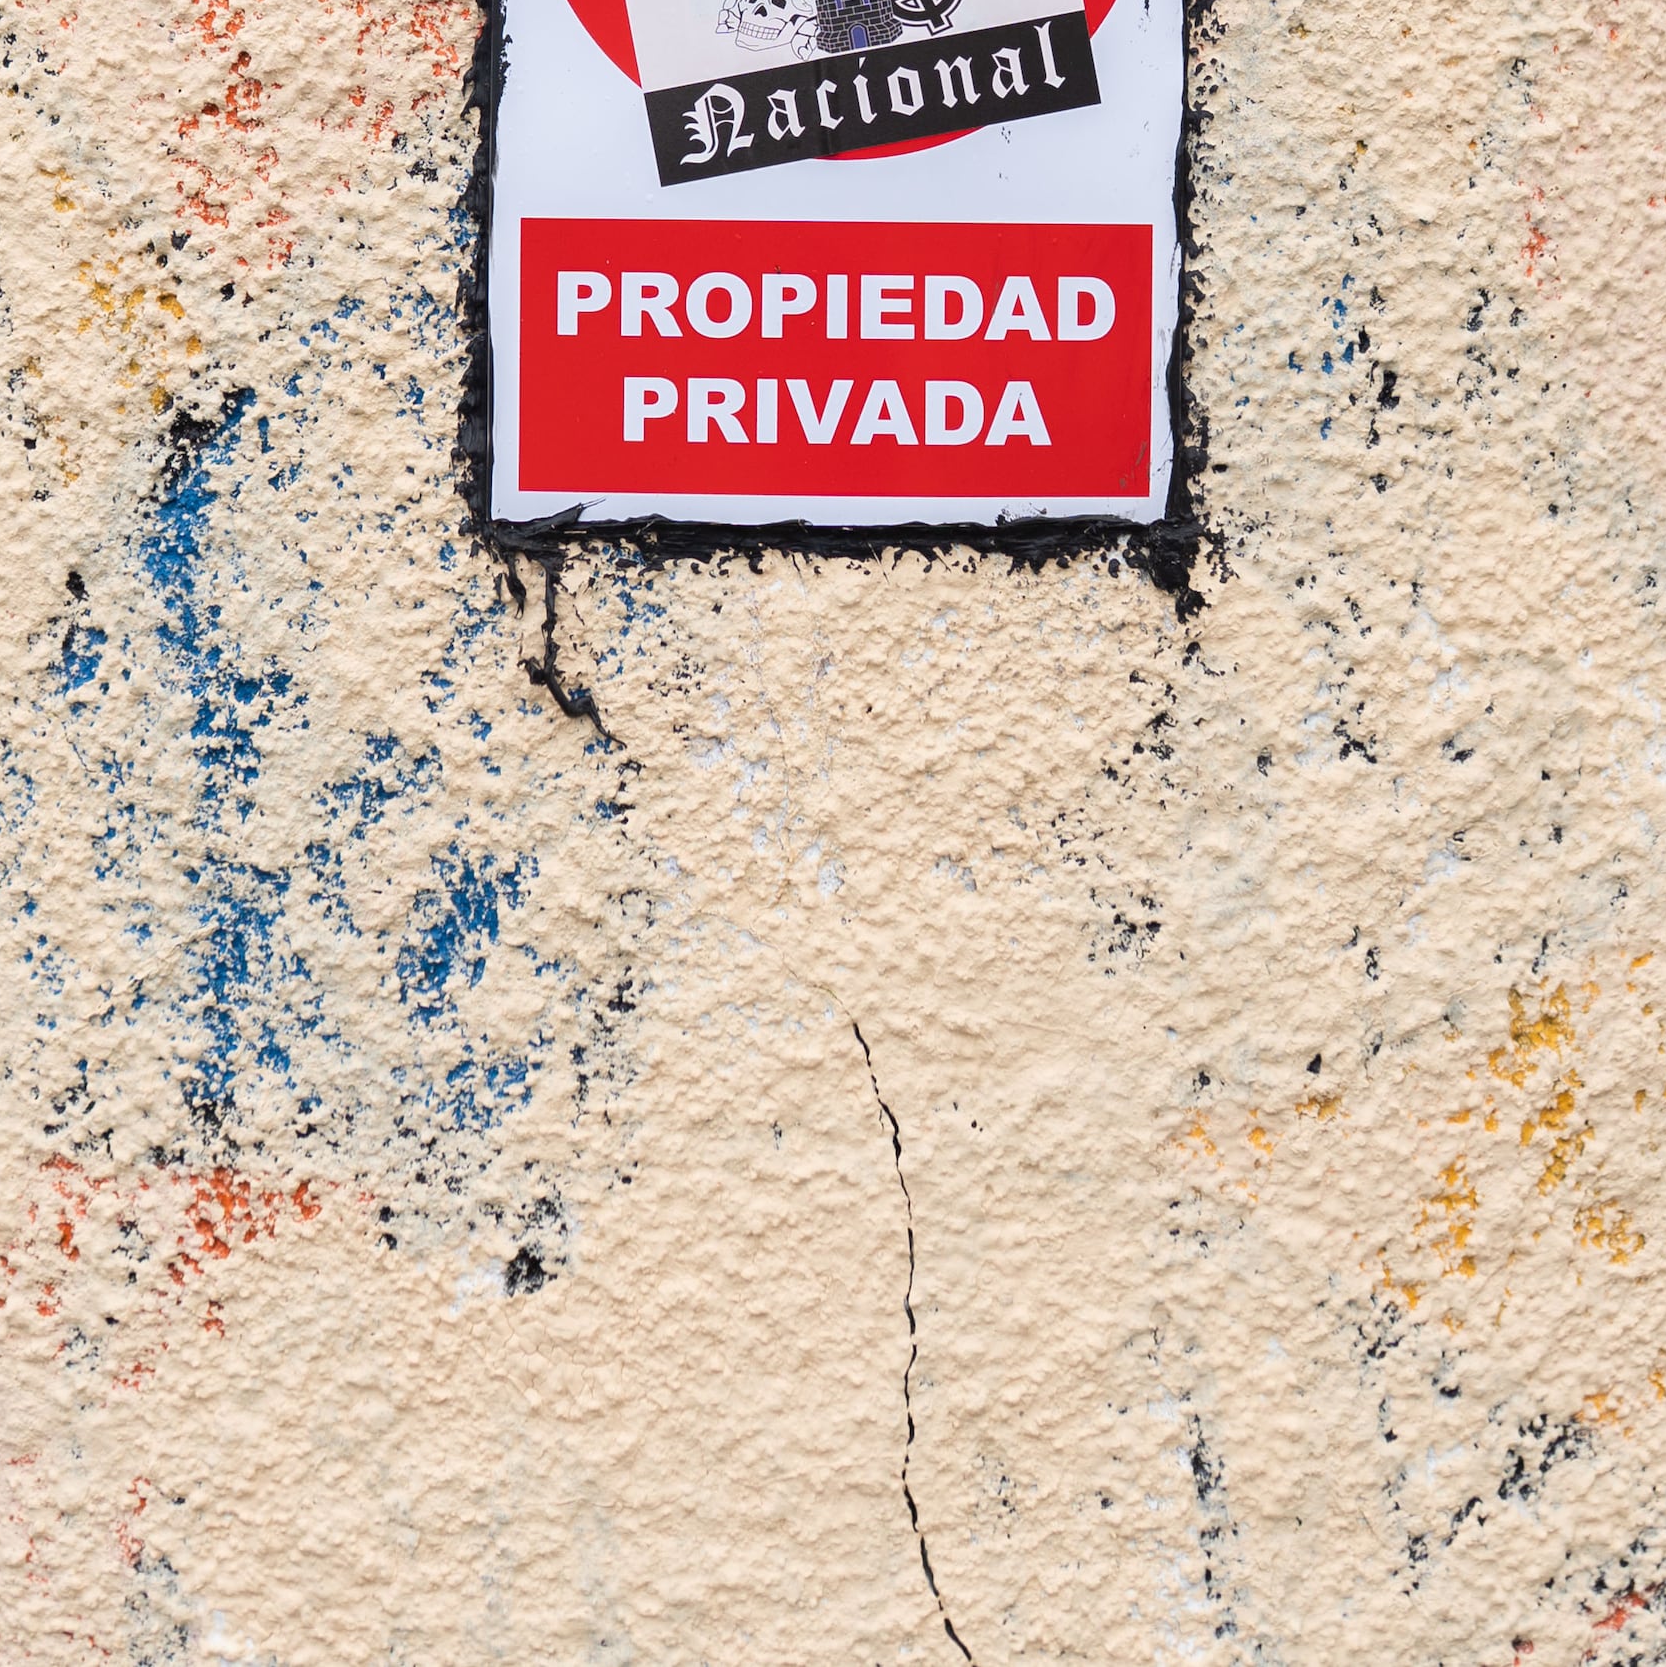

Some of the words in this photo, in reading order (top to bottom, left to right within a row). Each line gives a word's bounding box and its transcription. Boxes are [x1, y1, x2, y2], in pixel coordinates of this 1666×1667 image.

[679, 21, 1066, 165] Nacional
[557, 270, 1116, 341] PROPIEDAD
[623, 376, 1052, 446] PRIVADA
